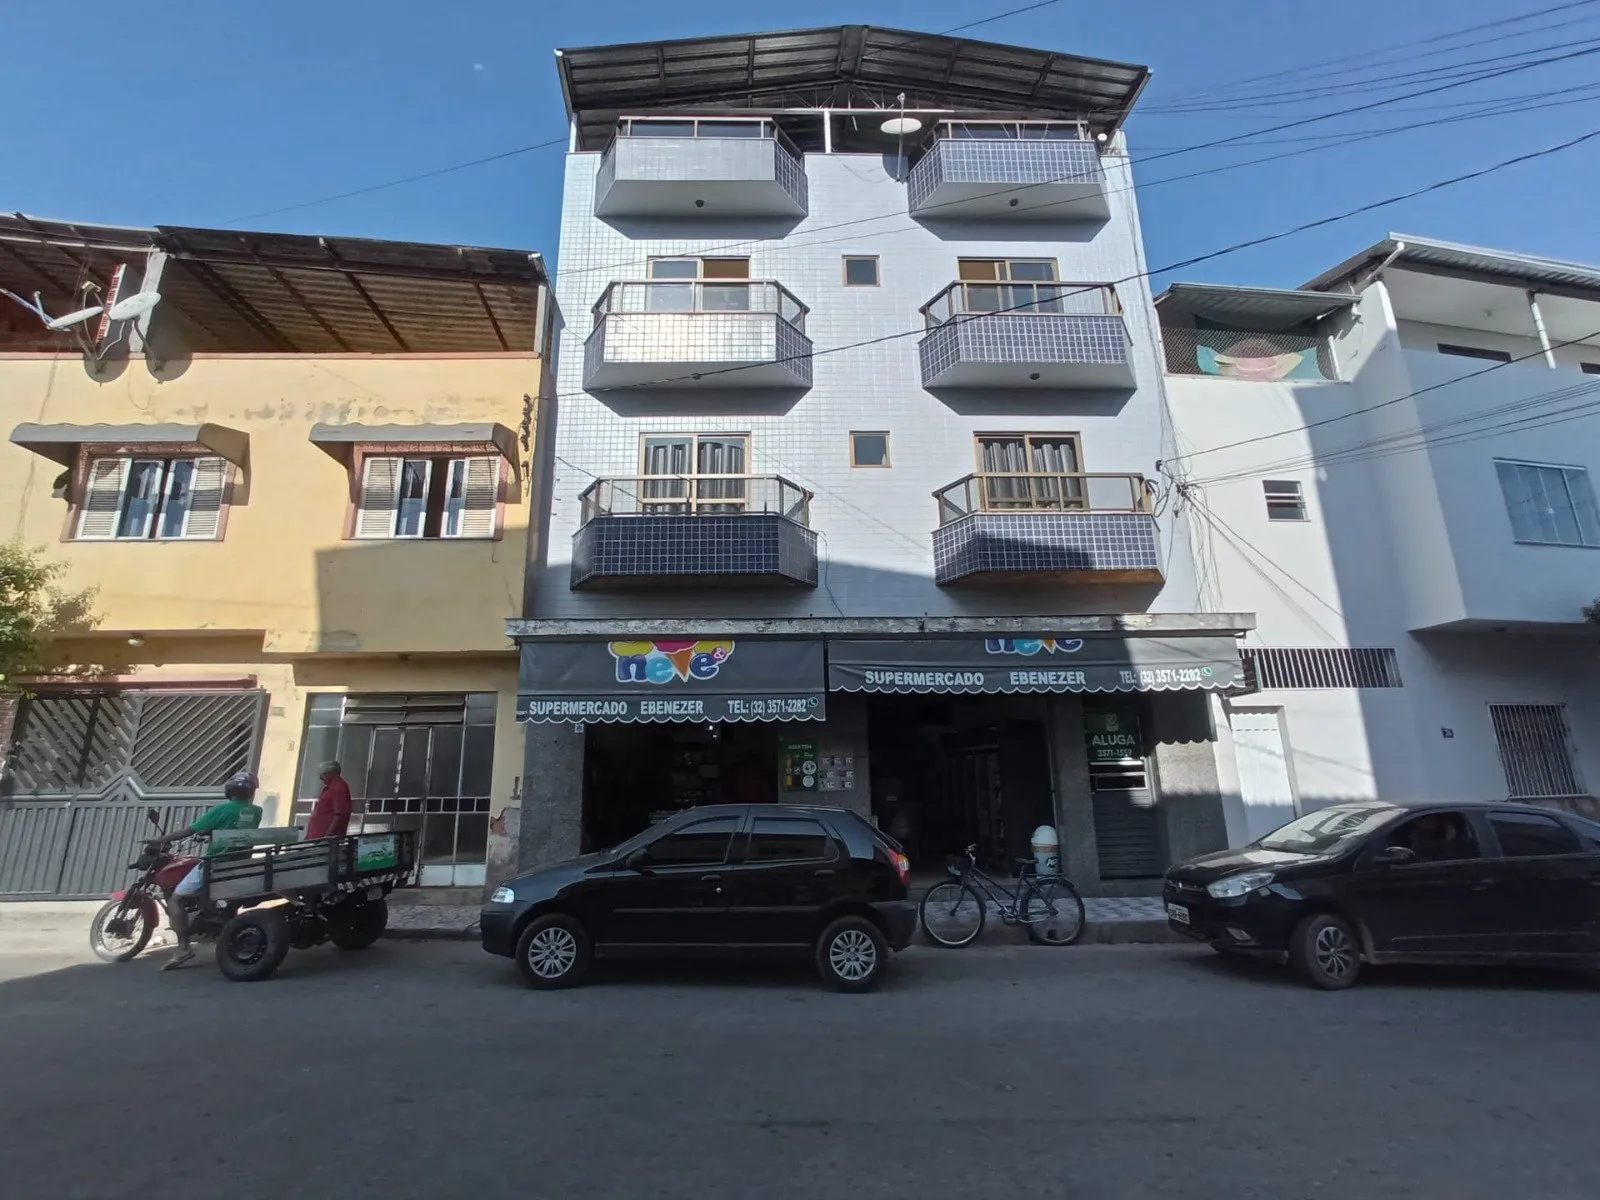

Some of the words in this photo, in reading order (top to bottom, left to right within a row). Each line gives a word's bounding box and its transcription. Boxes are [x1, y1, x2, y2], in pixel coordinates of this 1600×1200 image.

[865, 670, 985, 686] SUPERMERCADO
[1009, 671, 1086, 685] EBENEZER
[1119, 670, 1137, 684] TEL:
[1139, 669, 1155, 686] (32)
[529, 700, 628, 715] SUPERMERCADO
[640, 700, 704, 715] EBENEZER
[727, 699, 749, 714] TEL:
[750, 699, 766, 716] (32)
[767, 698, 807, 713] 3571-2282
[1091, 734, 1136, 746] ALUGA
